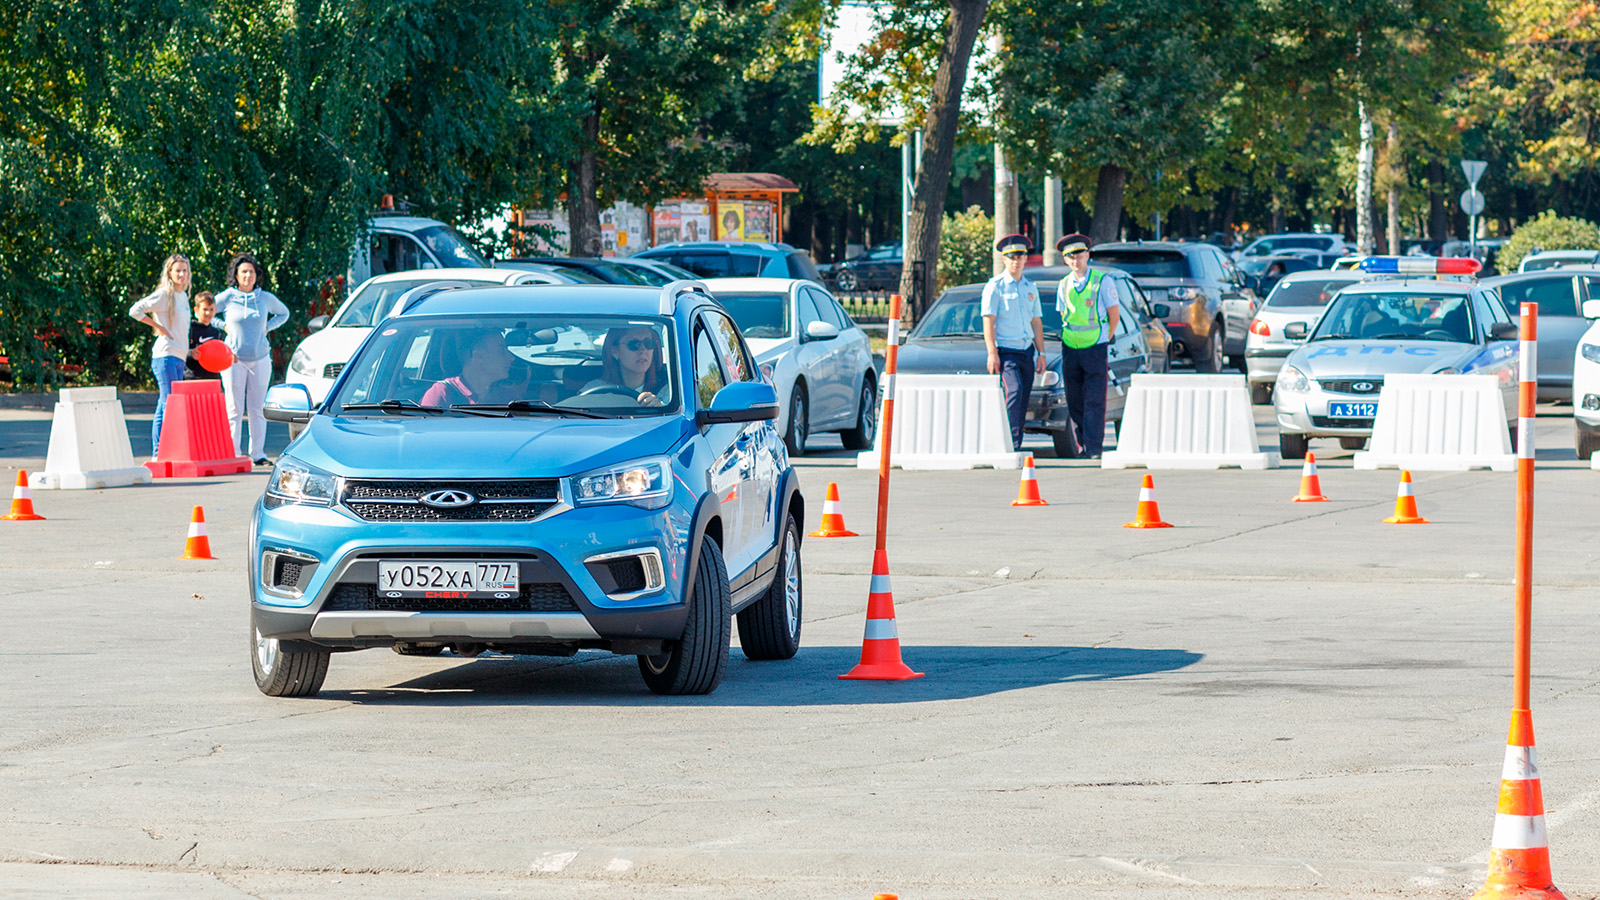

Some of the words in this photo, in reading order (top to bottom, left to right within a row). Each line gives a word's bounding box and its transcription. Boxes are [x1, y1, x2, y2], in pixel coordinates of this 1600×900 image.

[1307, 346, 1439, 359] ДПС
[1345, 404, 1375, 416] 3112
[478, 564, 512, 582] 777
[485, 581, 503, 589] RUS
[425, 591, 470, 599] CHERY
